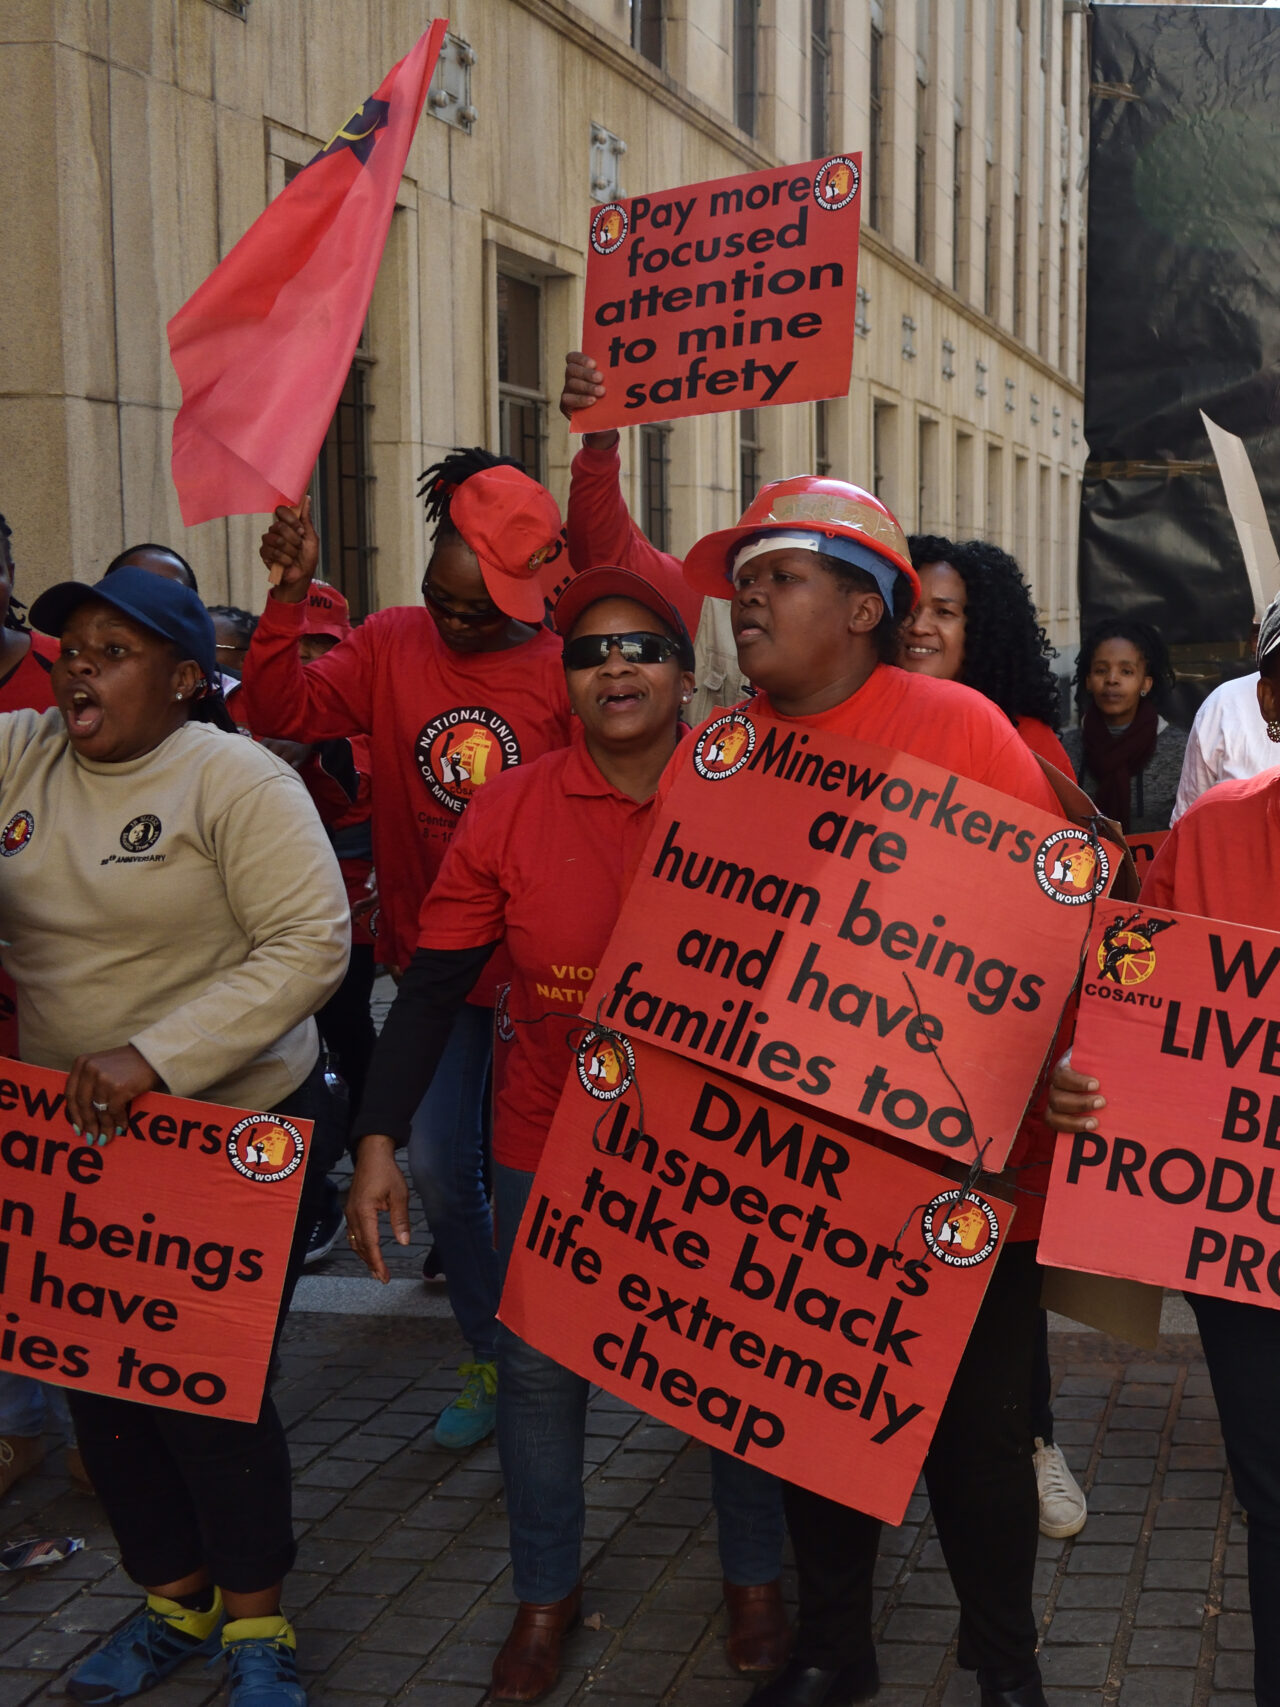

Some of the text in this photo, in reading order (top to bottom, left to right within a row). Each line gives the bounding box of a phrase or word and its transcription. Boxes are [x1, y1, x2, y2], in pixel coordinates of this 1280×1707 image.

[630, 176, 811, 235] Pay more
[628, 205, 809, 277] focused
[595, 261, 843, 326] attention
[608, 308, 822, 368] to mine
[624, 357, 799, 409] safety
[420, 709, 518, 765] NATIONAL UNION
[421, 765, 462, 812] OF MINE
[747, 726, 1037, 864] Mineworkers
[808, 810, 908, 873] are
[1036, 855, 1045, 868] OF
[1037, 871, 1055, 897] MINE
[652, 821, 821, 926] human
[837, 879, 1045, 1015] beings
[676, 928, 945, 1054] and have
[1085, 983, 1163, 1009] COSATU
[605, 962, 835, 1096] families
[857, 1065, 974, 1149] too
[1, 1128, 103, 1184] are
[228, 1143, 301, 1182] OF MINE WORKERS
[232, 1114, 304, 1151] NATIONAL UNION
[690, 1081, 851, 1201] DMR
[605, 1102, 931, 1297] Inspectors
[981, 1203, 998, 1239] UNION
[59, 1191, 264, 1291] beings
[582, 1167, 922, 1367] take black
[924, 1215, 932, 1229] OF
[944, 1244, 993, 1266] WORKERS
[30, 1251, 178, 1332] have
[526, 1196, 925, 1446] life extremely
[118, 1347, 227, 1405] too
[592, 1323, 785, 1456] cheap
